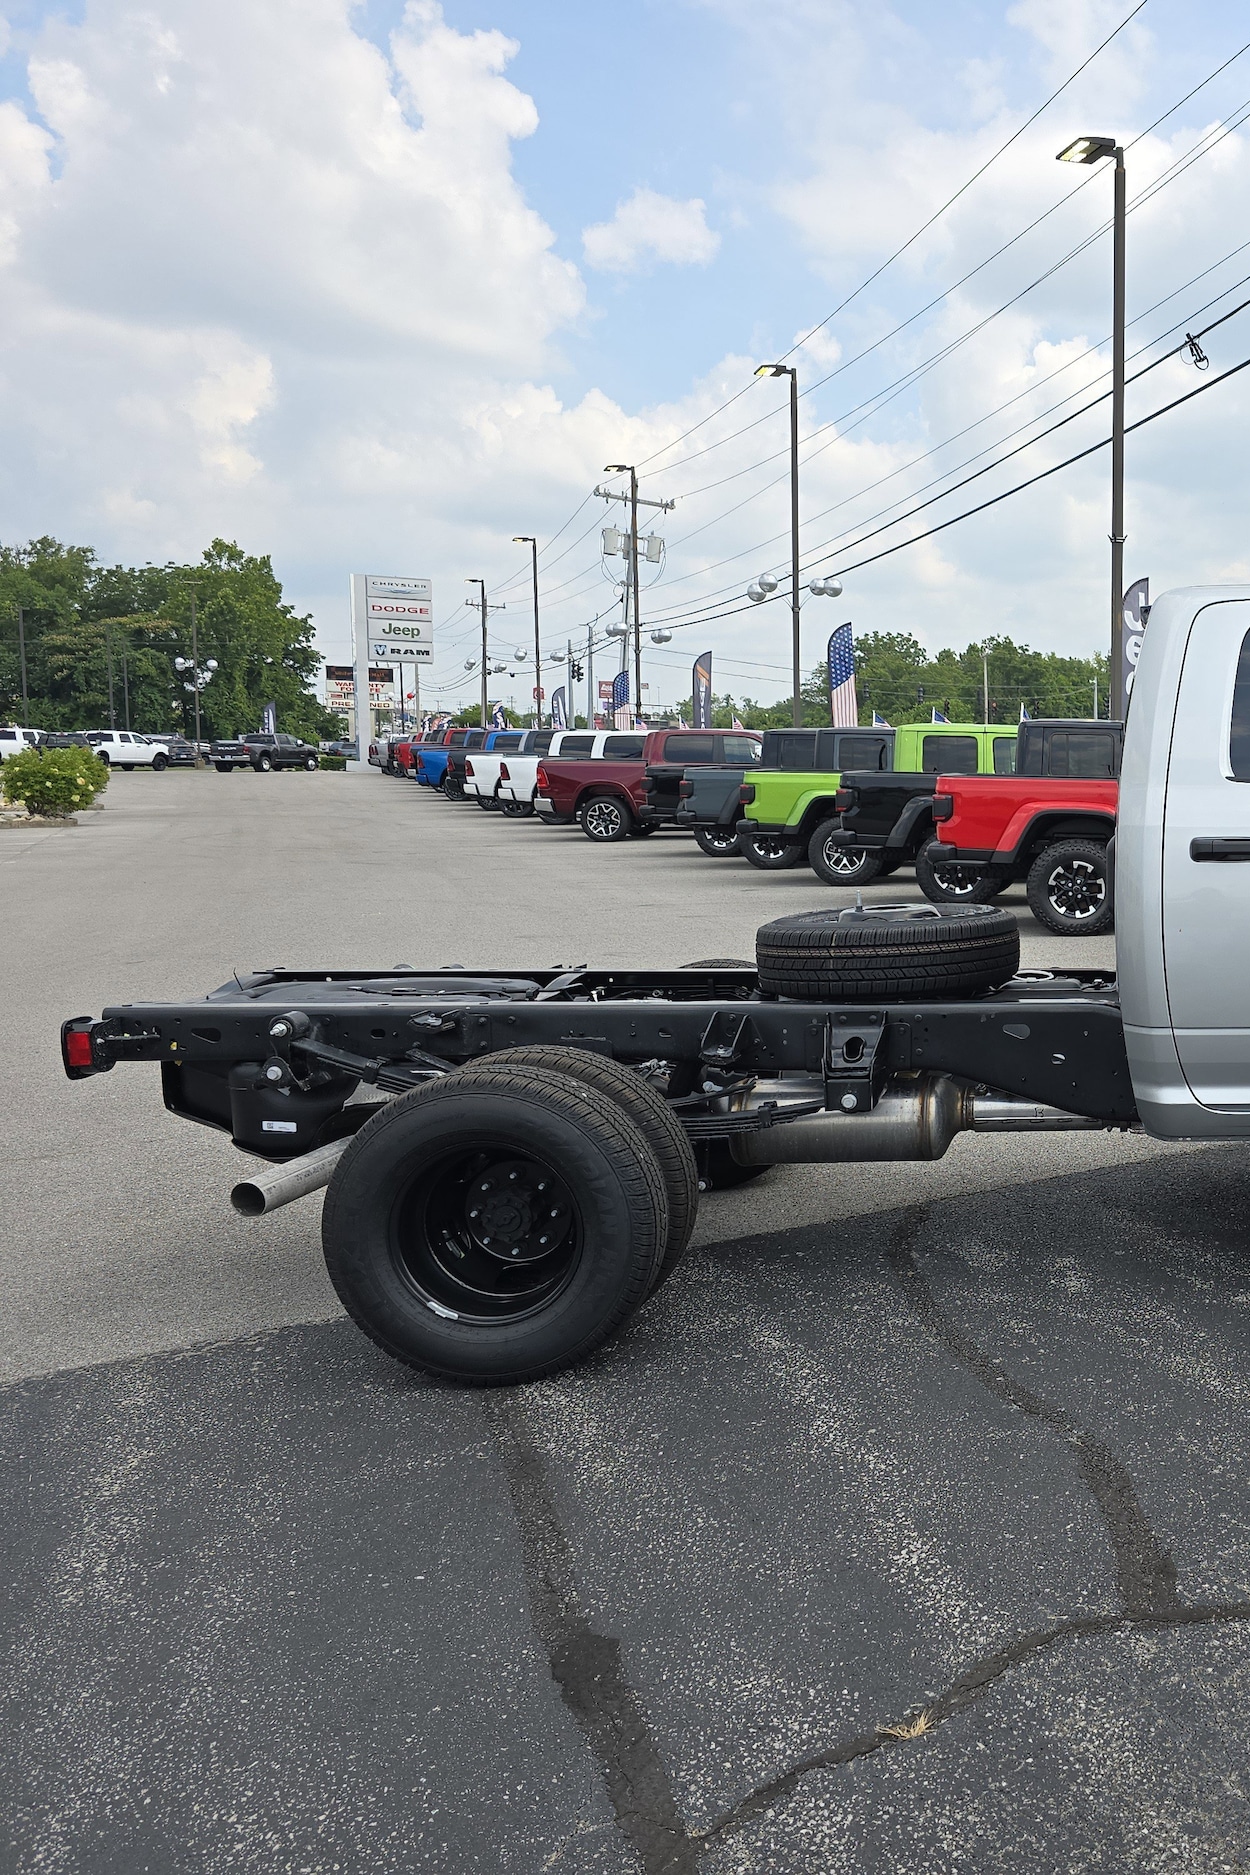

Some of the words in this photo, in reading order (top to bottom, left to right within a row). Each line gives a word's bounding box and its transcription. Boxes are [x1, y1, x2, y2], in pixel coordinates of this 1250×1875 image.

[372, 581, 427, 589] CHRYSLER
[371, 604, 430, 615] DODGE
[382, 622, 421, 638] Jeep
[390, 648, 430, 656] RAM
